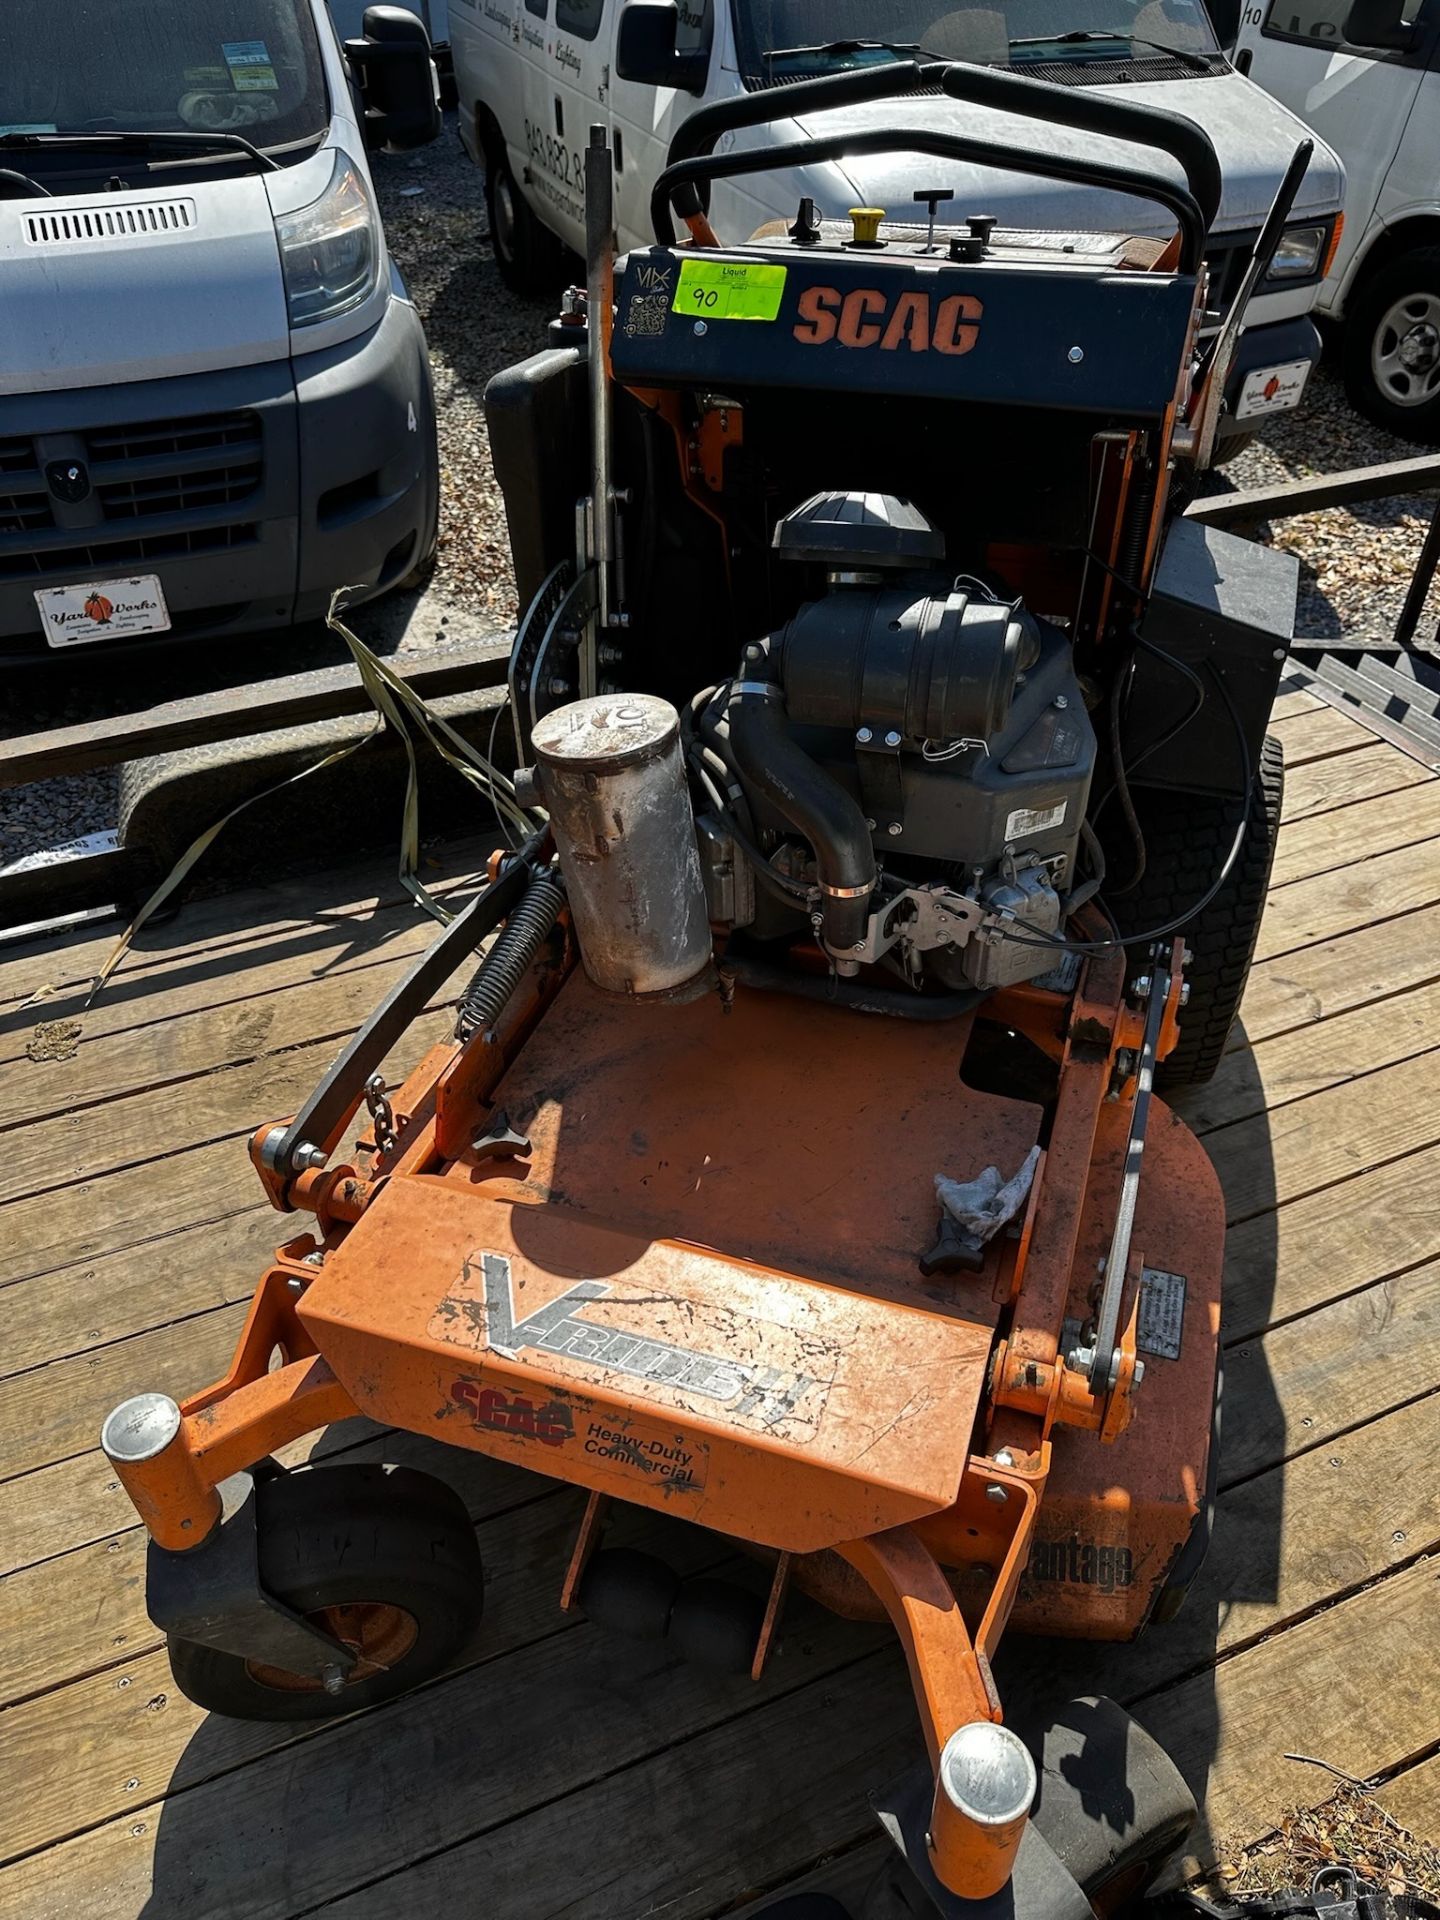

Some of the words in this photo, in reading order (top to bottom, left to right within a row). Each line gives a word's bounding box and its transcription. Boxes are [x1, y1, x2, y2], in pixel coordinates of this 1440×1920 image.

[722, 267, 747, 276] Liquid
[693, 288, 718, 308] 90
[793, 286, 984, 355] SCAG
[107, 600, 157, 615] Works
[588, 1423, 693, 1467] Heavy-Duty
[1032, 1536, 1132, 1594] antage
